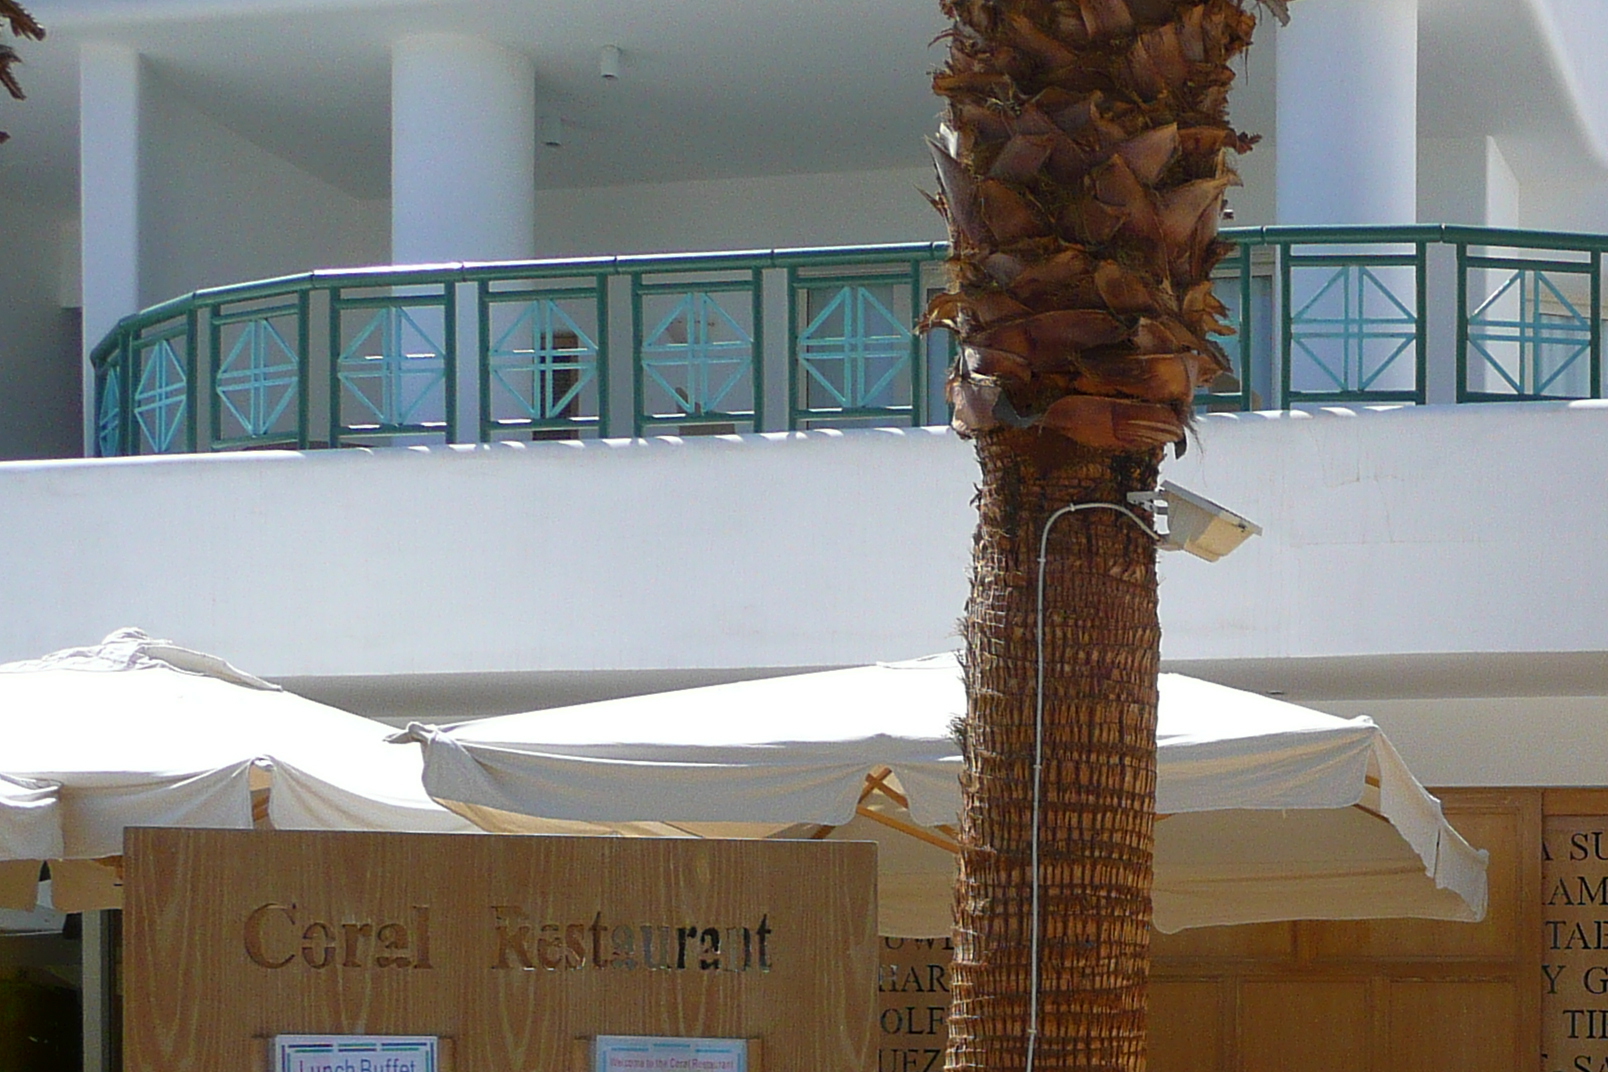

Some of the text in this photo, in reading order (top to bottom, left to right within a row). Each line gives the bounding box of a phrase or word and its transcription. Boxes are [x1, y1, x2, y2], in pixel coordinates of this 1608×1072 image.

[243, 902, 773, 972] Coral Restaurant
[1541, 965, 1566, 994] Y
